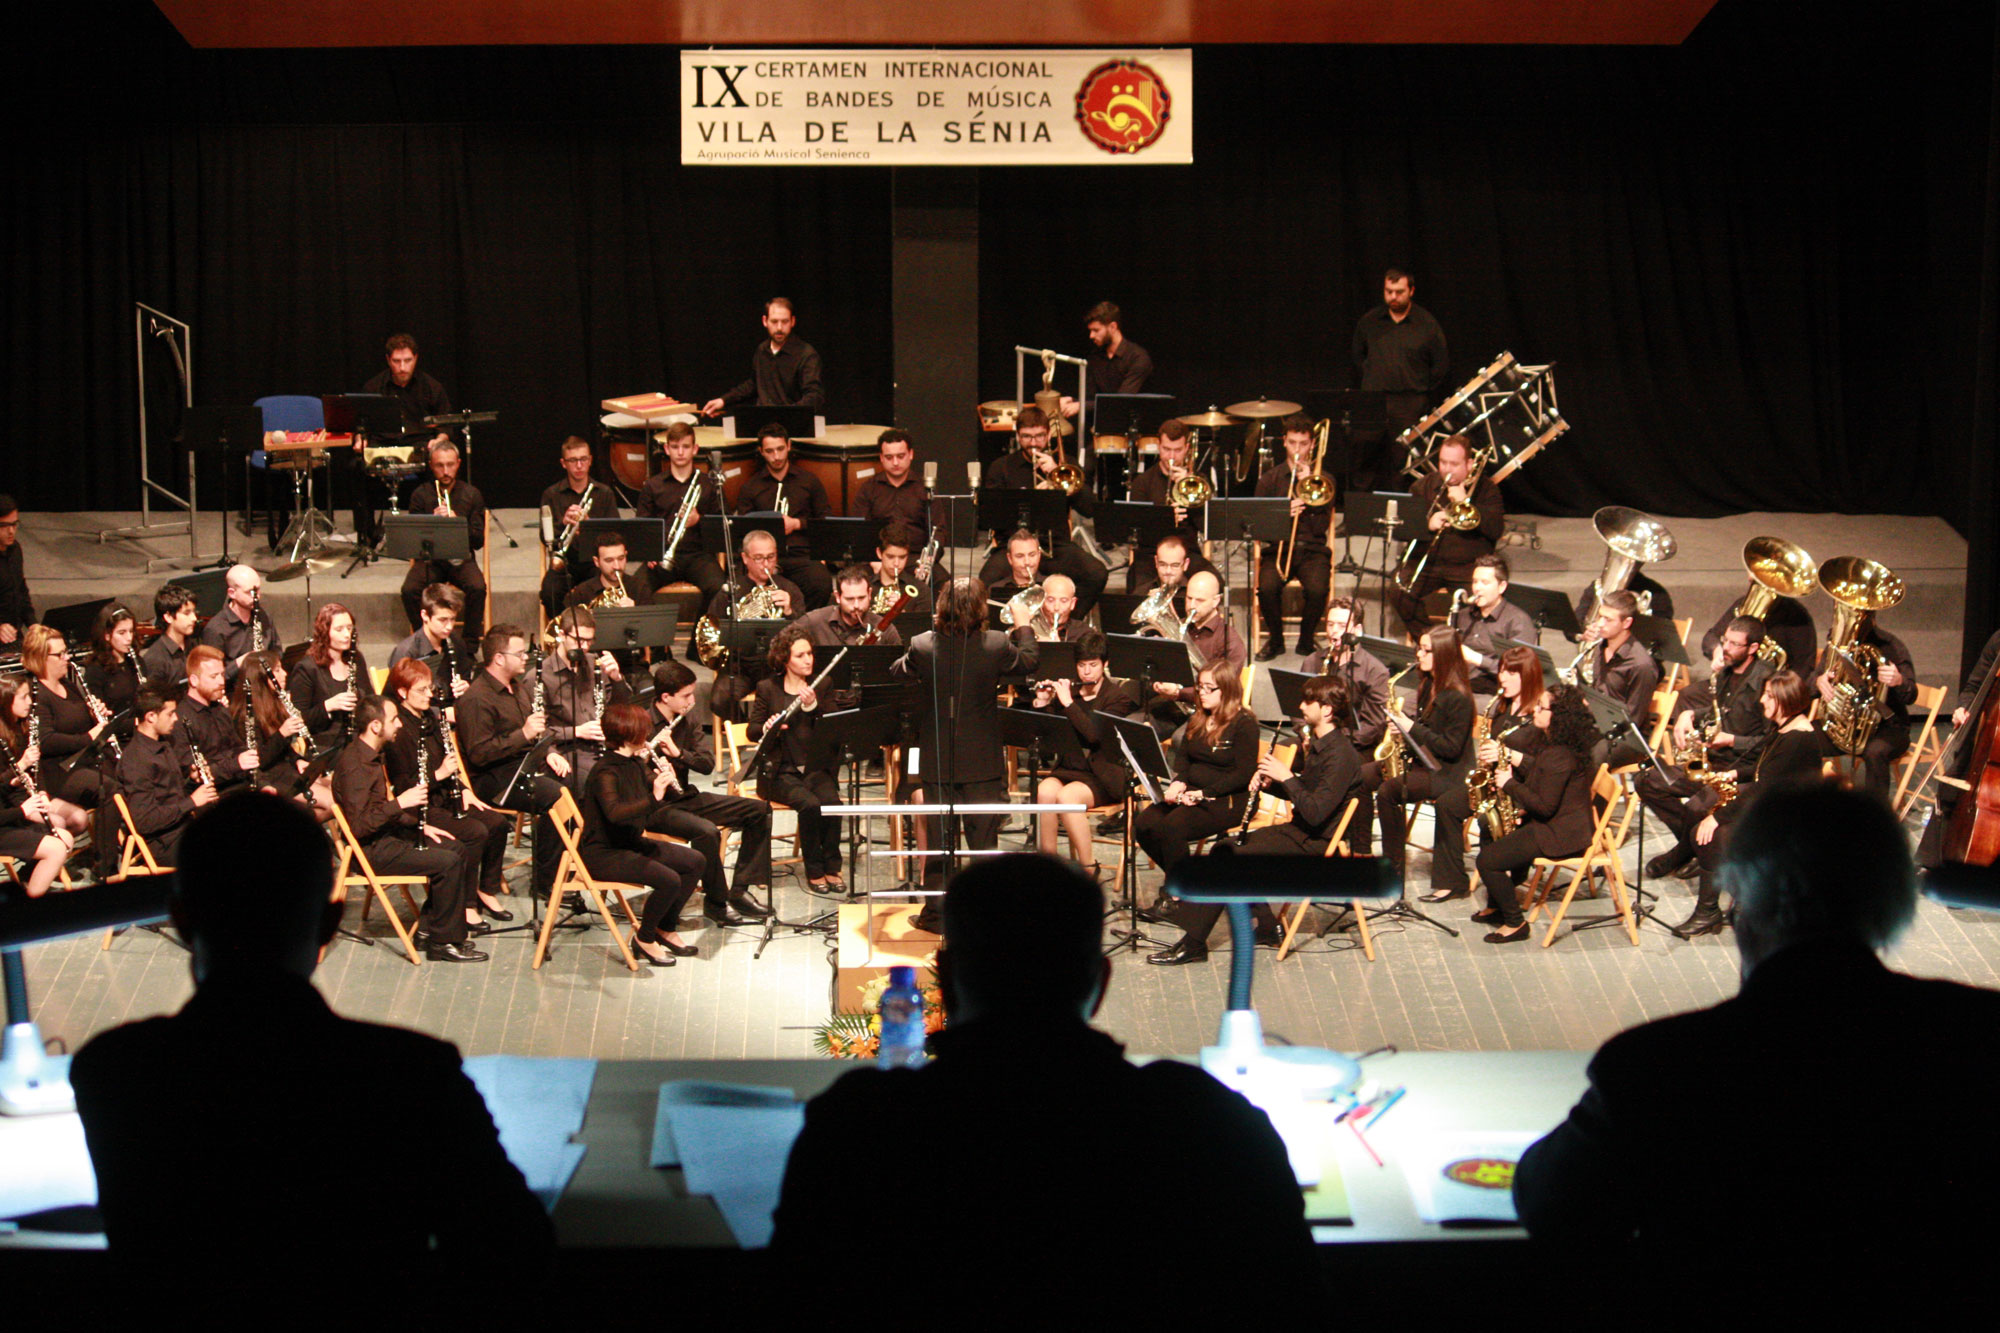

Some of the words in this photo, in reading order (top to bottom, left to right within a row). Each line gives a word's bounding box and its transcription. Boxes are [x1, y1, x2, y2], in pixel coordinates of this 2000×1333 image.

[755, 61, 867, 78] CERTAMEN
[885, 61, 1053, 78] INTERNACIONAL
[692, 65, 749, 108] IX
[756, 91, 783, 107] DE
[806, 91, 894, 107] BANDES
[917, 91, 945, 107] DE
[968, 85, 1052, 107] MÚSICA
[697, 121, 777, 143] VILA
[805, 121, 849, 143] DE
[877, 121, 917, 143] LA
[943, 111, 1052, 143] SÉNIA
